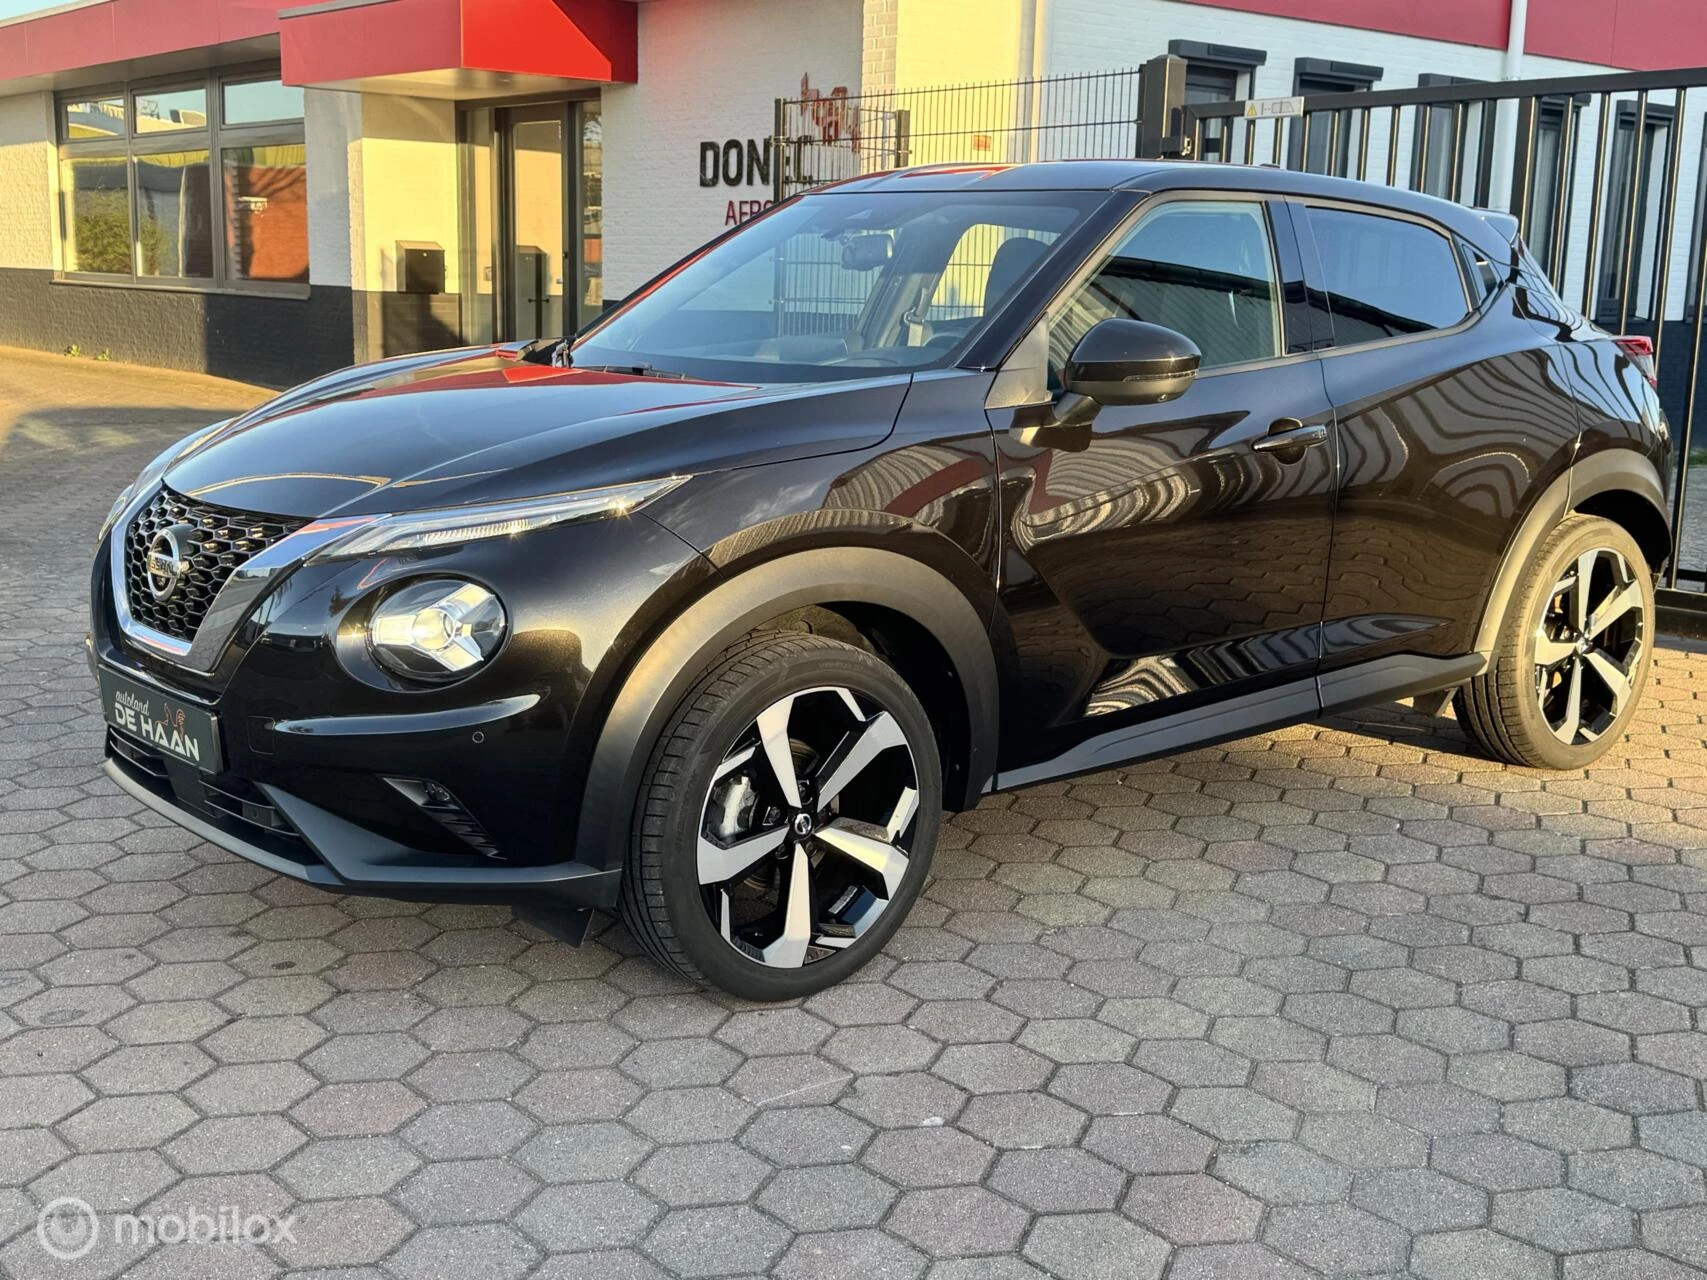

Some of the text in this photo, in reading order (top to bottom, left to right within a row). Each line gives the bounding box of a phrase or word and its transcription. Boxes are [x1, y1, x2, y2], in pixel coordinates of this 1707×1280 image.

[147, 554, 176, 577] SSAN
[115, 690, 150, 716] autoland
[114, 702, 200, 761] DE HAAN
